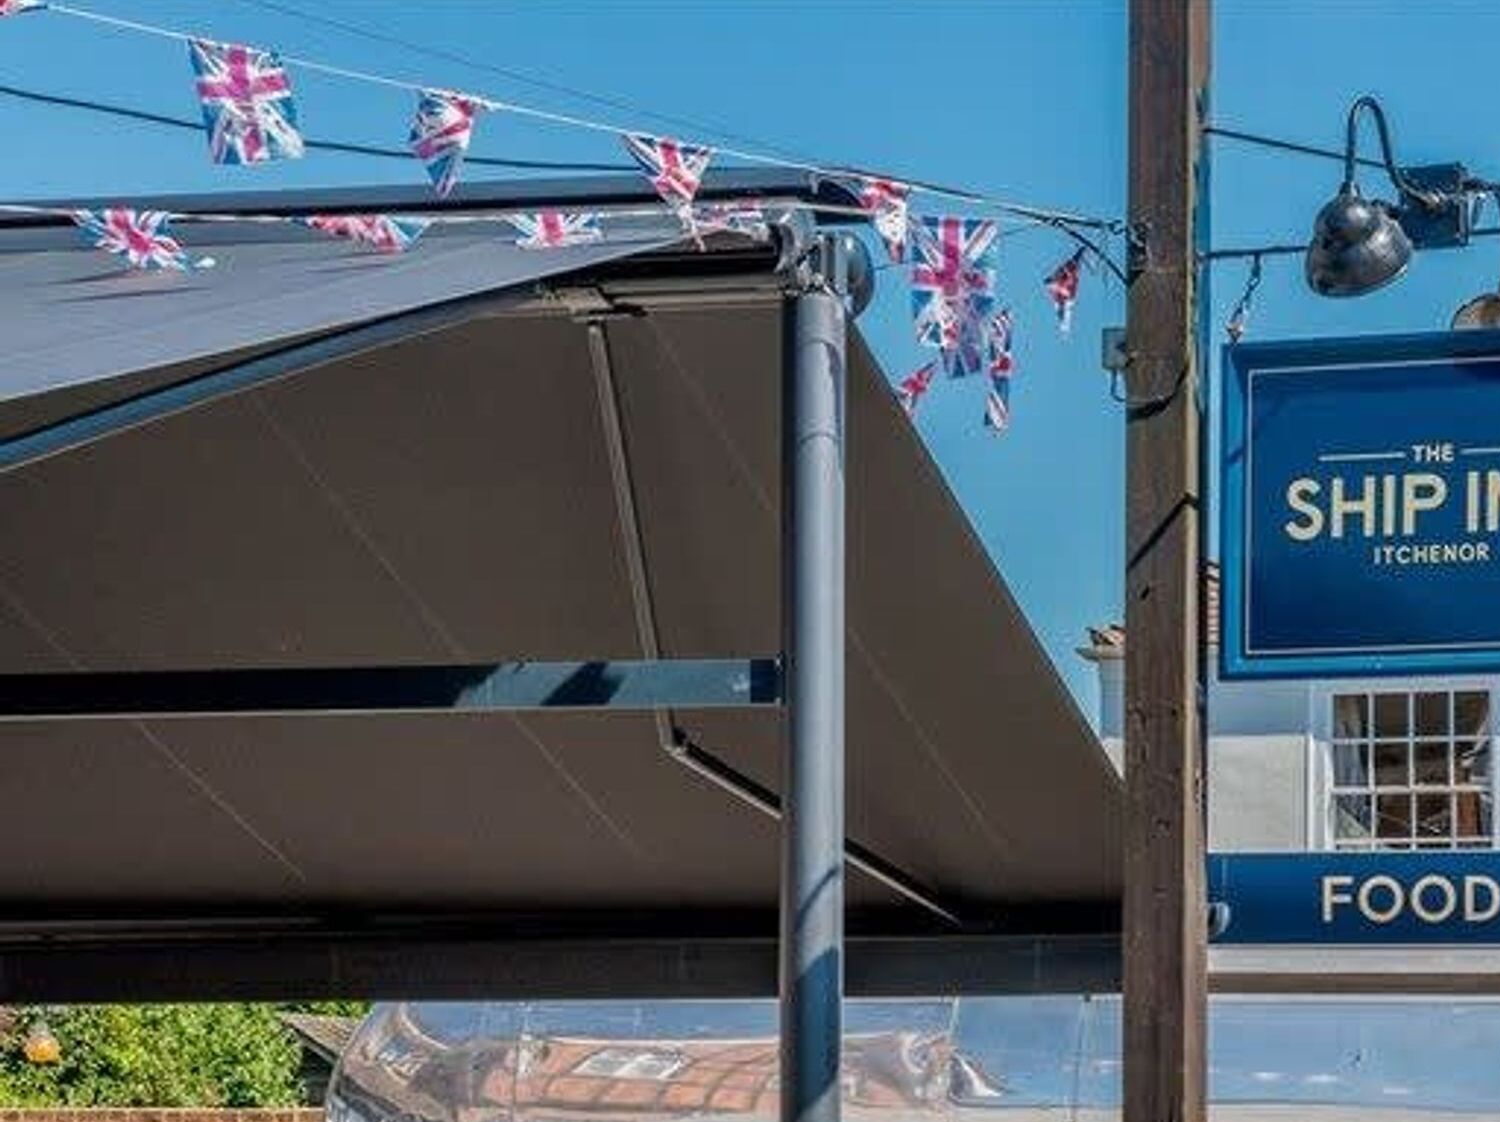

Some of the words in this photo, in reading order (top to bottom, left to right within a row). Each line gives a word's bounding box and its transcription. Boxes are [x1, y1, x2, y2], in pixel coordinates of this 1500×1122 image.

[1412, 443, 1455, 463] THE
[1284, 473, 1446, 542] SHIP
[1373, 542, 1490, 566] ITCHENOR
